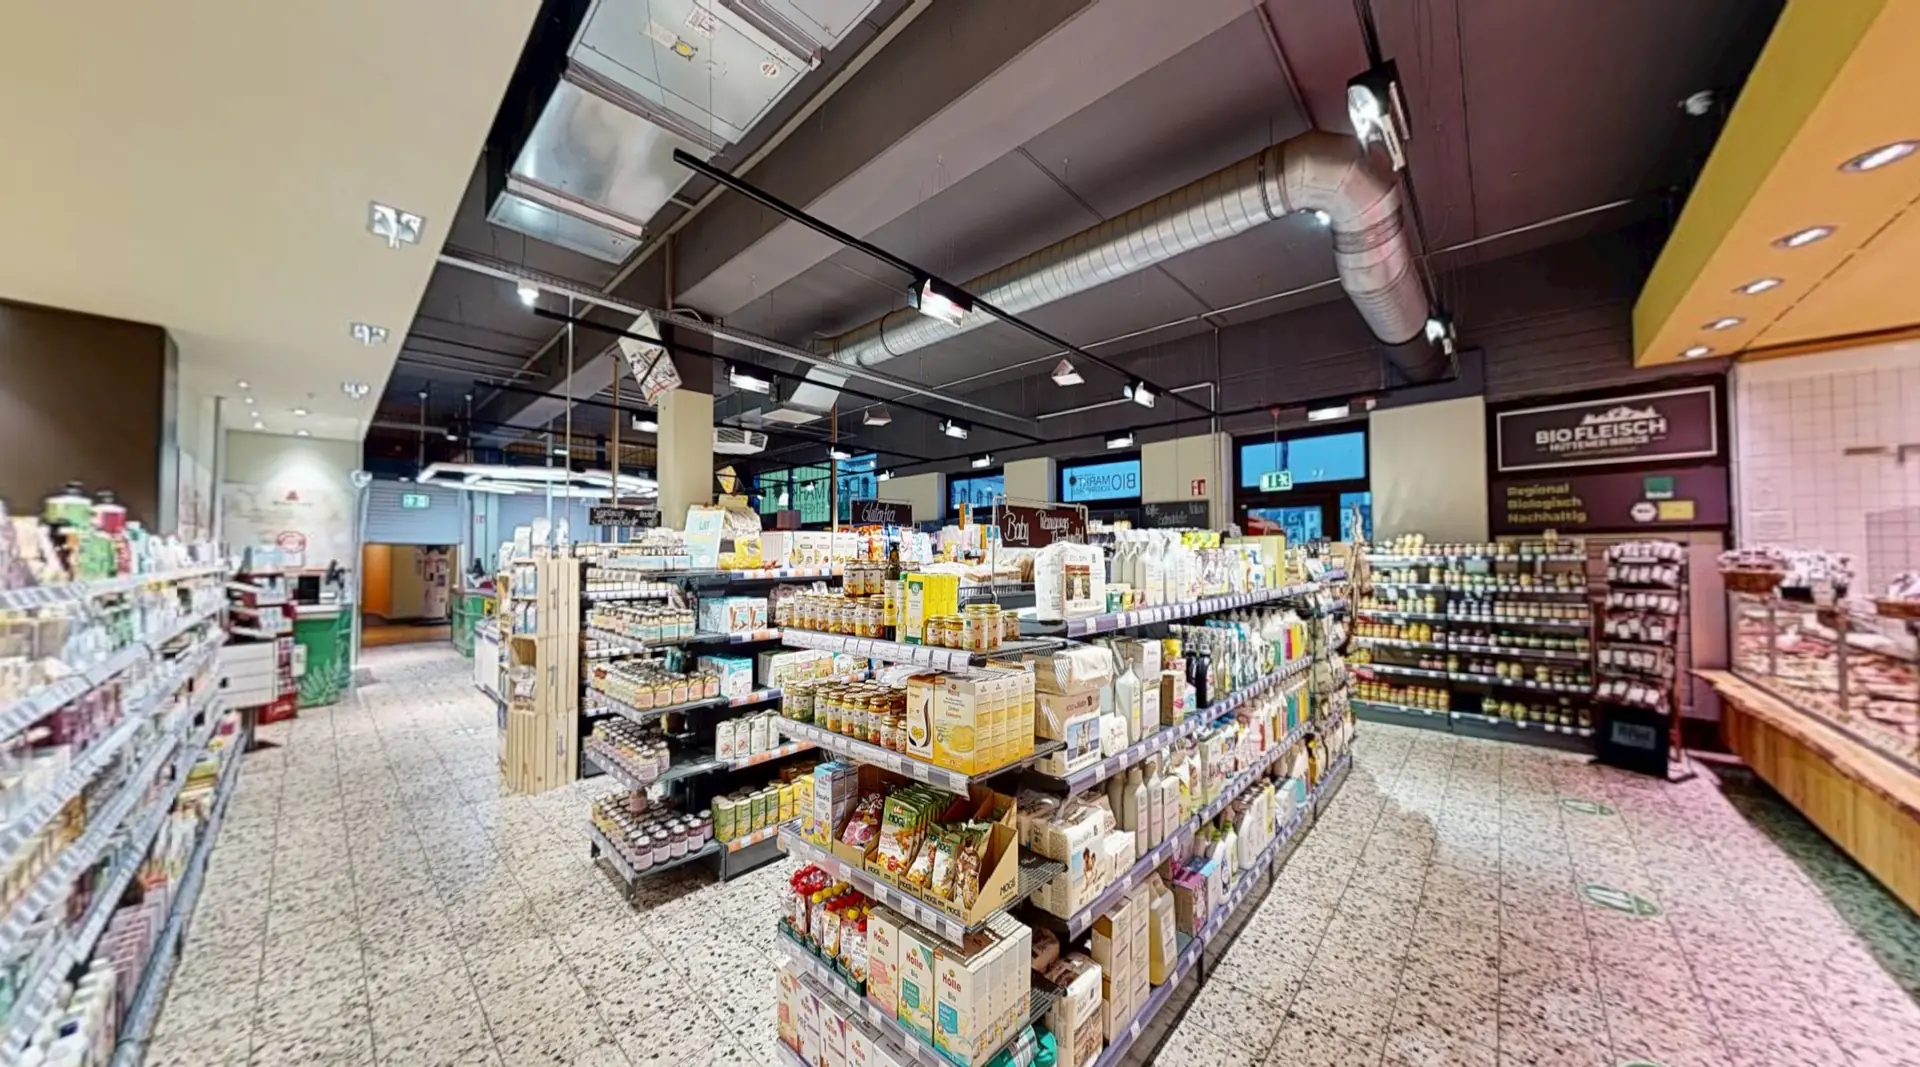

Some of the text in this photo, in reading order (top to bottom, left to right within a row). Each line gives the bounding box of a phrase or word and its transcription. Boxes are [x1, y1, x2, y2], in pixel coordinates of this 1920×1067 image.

[1507, 483, 1570, 497] Regional
[1507, 497, 1584, 511] Biologisch
[1507, 510, 1587, 524] Nachhaltig
[1003, 512, 1029, 545] Baby
[873, 930, 889, 947] Holle
[906, 951, 923, 970] Holle
[942, 972, 961, 992] Holle
